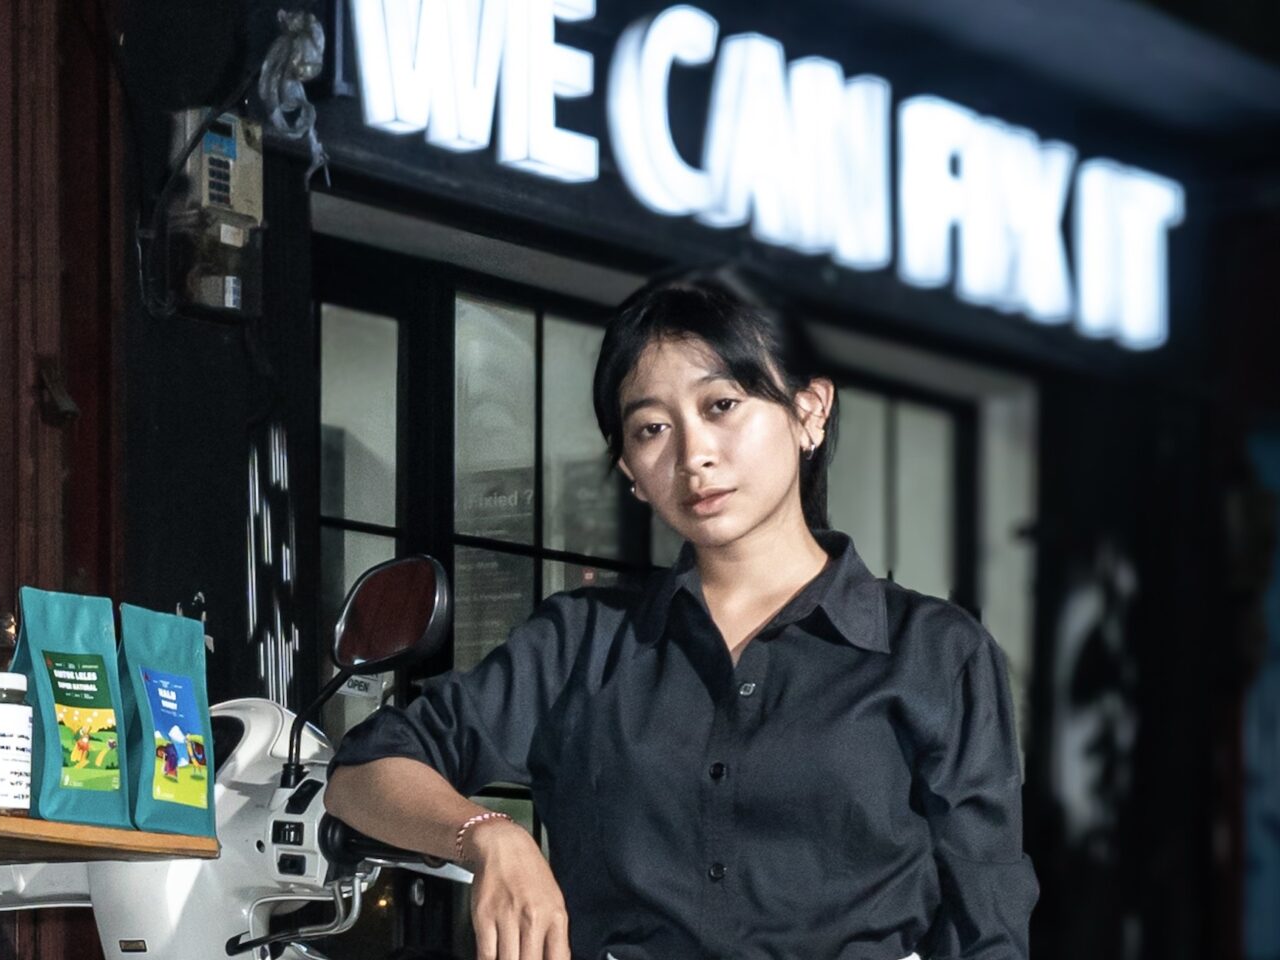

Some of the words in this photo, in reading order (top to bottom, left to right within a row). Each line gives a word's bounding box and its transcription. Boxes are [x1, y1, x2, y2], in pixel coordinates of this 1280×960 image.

[352, 0, 600, 182] WE
[606, 4, 894, 272] CAN
[896, 94, 1080, 325] FIX
[1072, 157, 1188, 350] IT
[347, 677, 370, 692] OPEN
